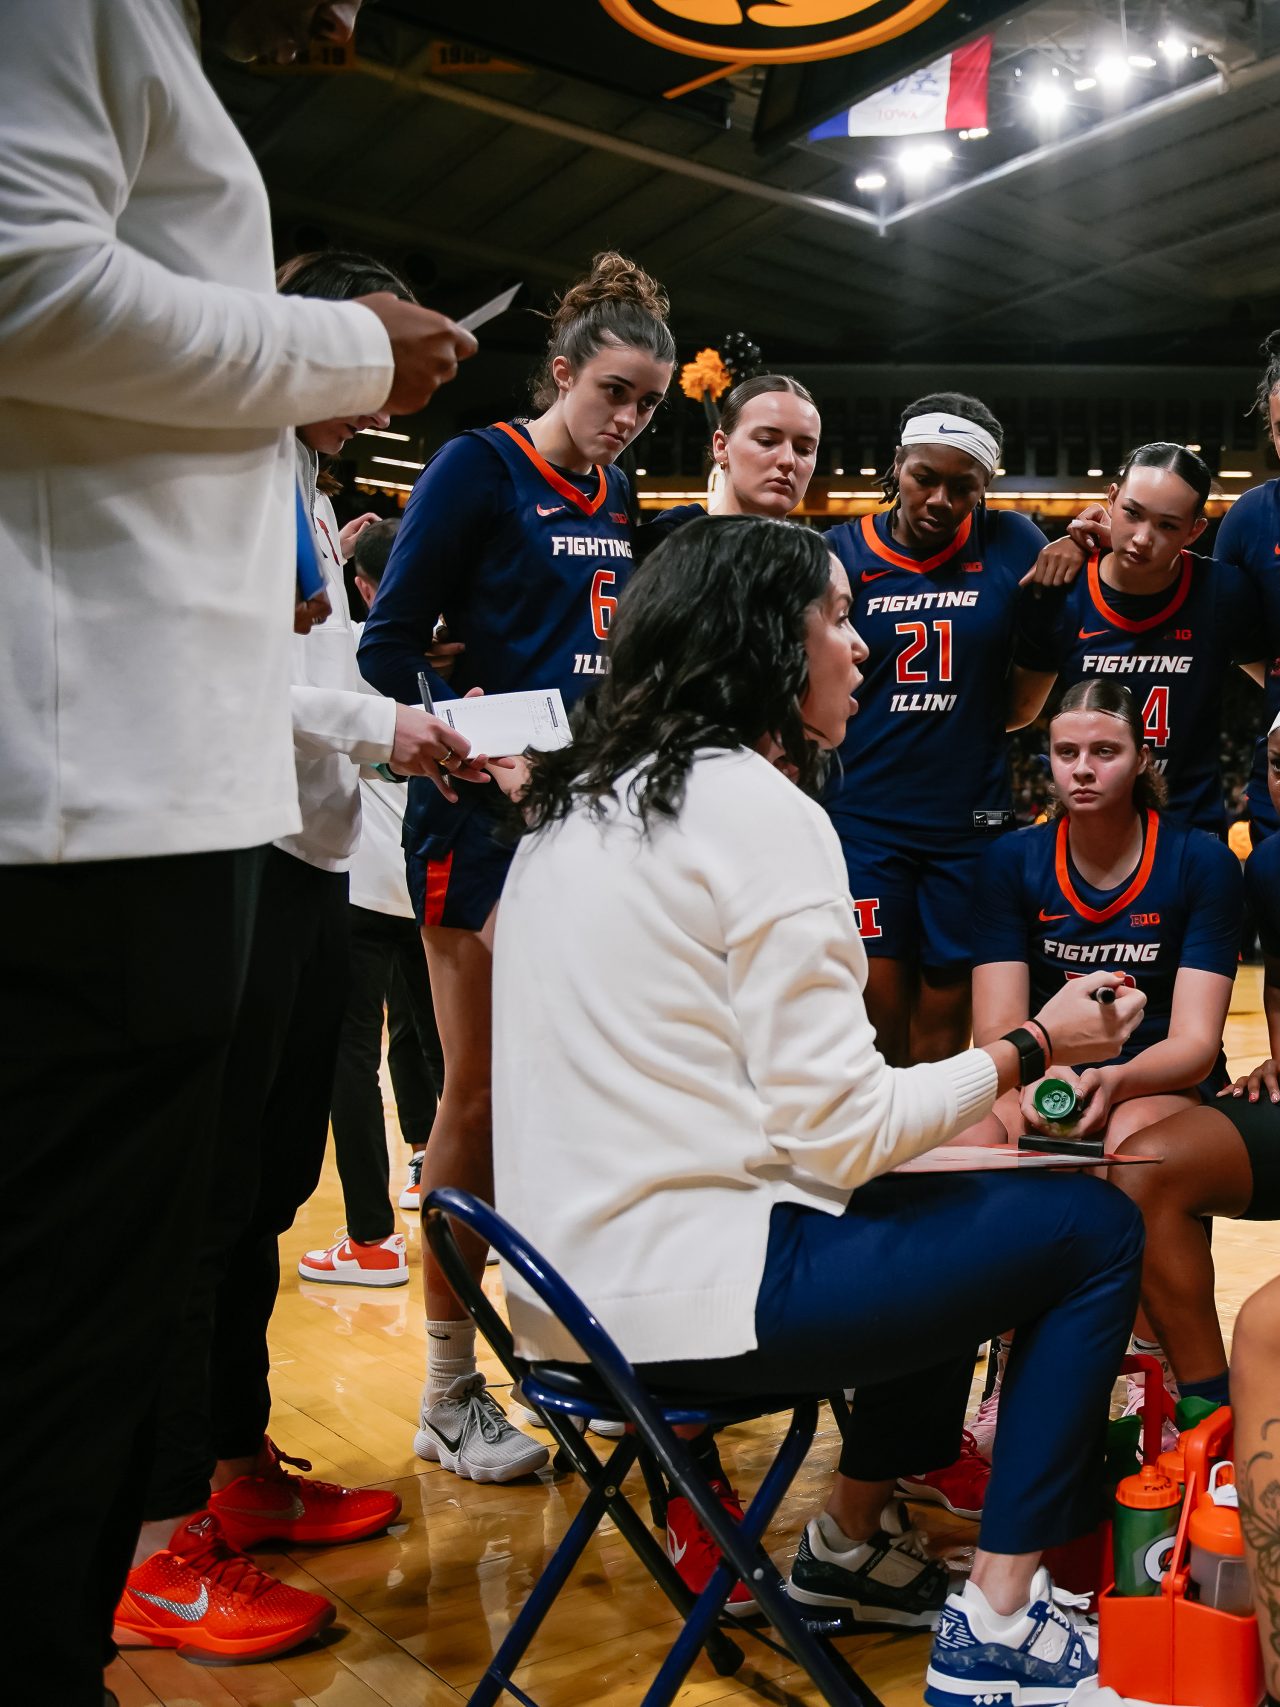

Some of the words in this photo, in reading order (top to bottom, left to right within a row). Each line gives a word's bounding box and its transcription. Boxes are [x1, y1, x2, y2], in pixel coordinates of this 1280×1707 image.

[551, 536, 633, 559] FIGHTING
[590, 569, 619, 640] 6
[867, 590, 979, 616] FIGHTING
[895, 620, 952, 684] 21
[1082, 655, 1194, 674] FIGHTING
[890, 693, 958, 713] ILLINI
[1123, 685, 1170, 747] 4
[853, 898, 882, 938] I
[1044, 939, 1161, 963] FIGHTING
